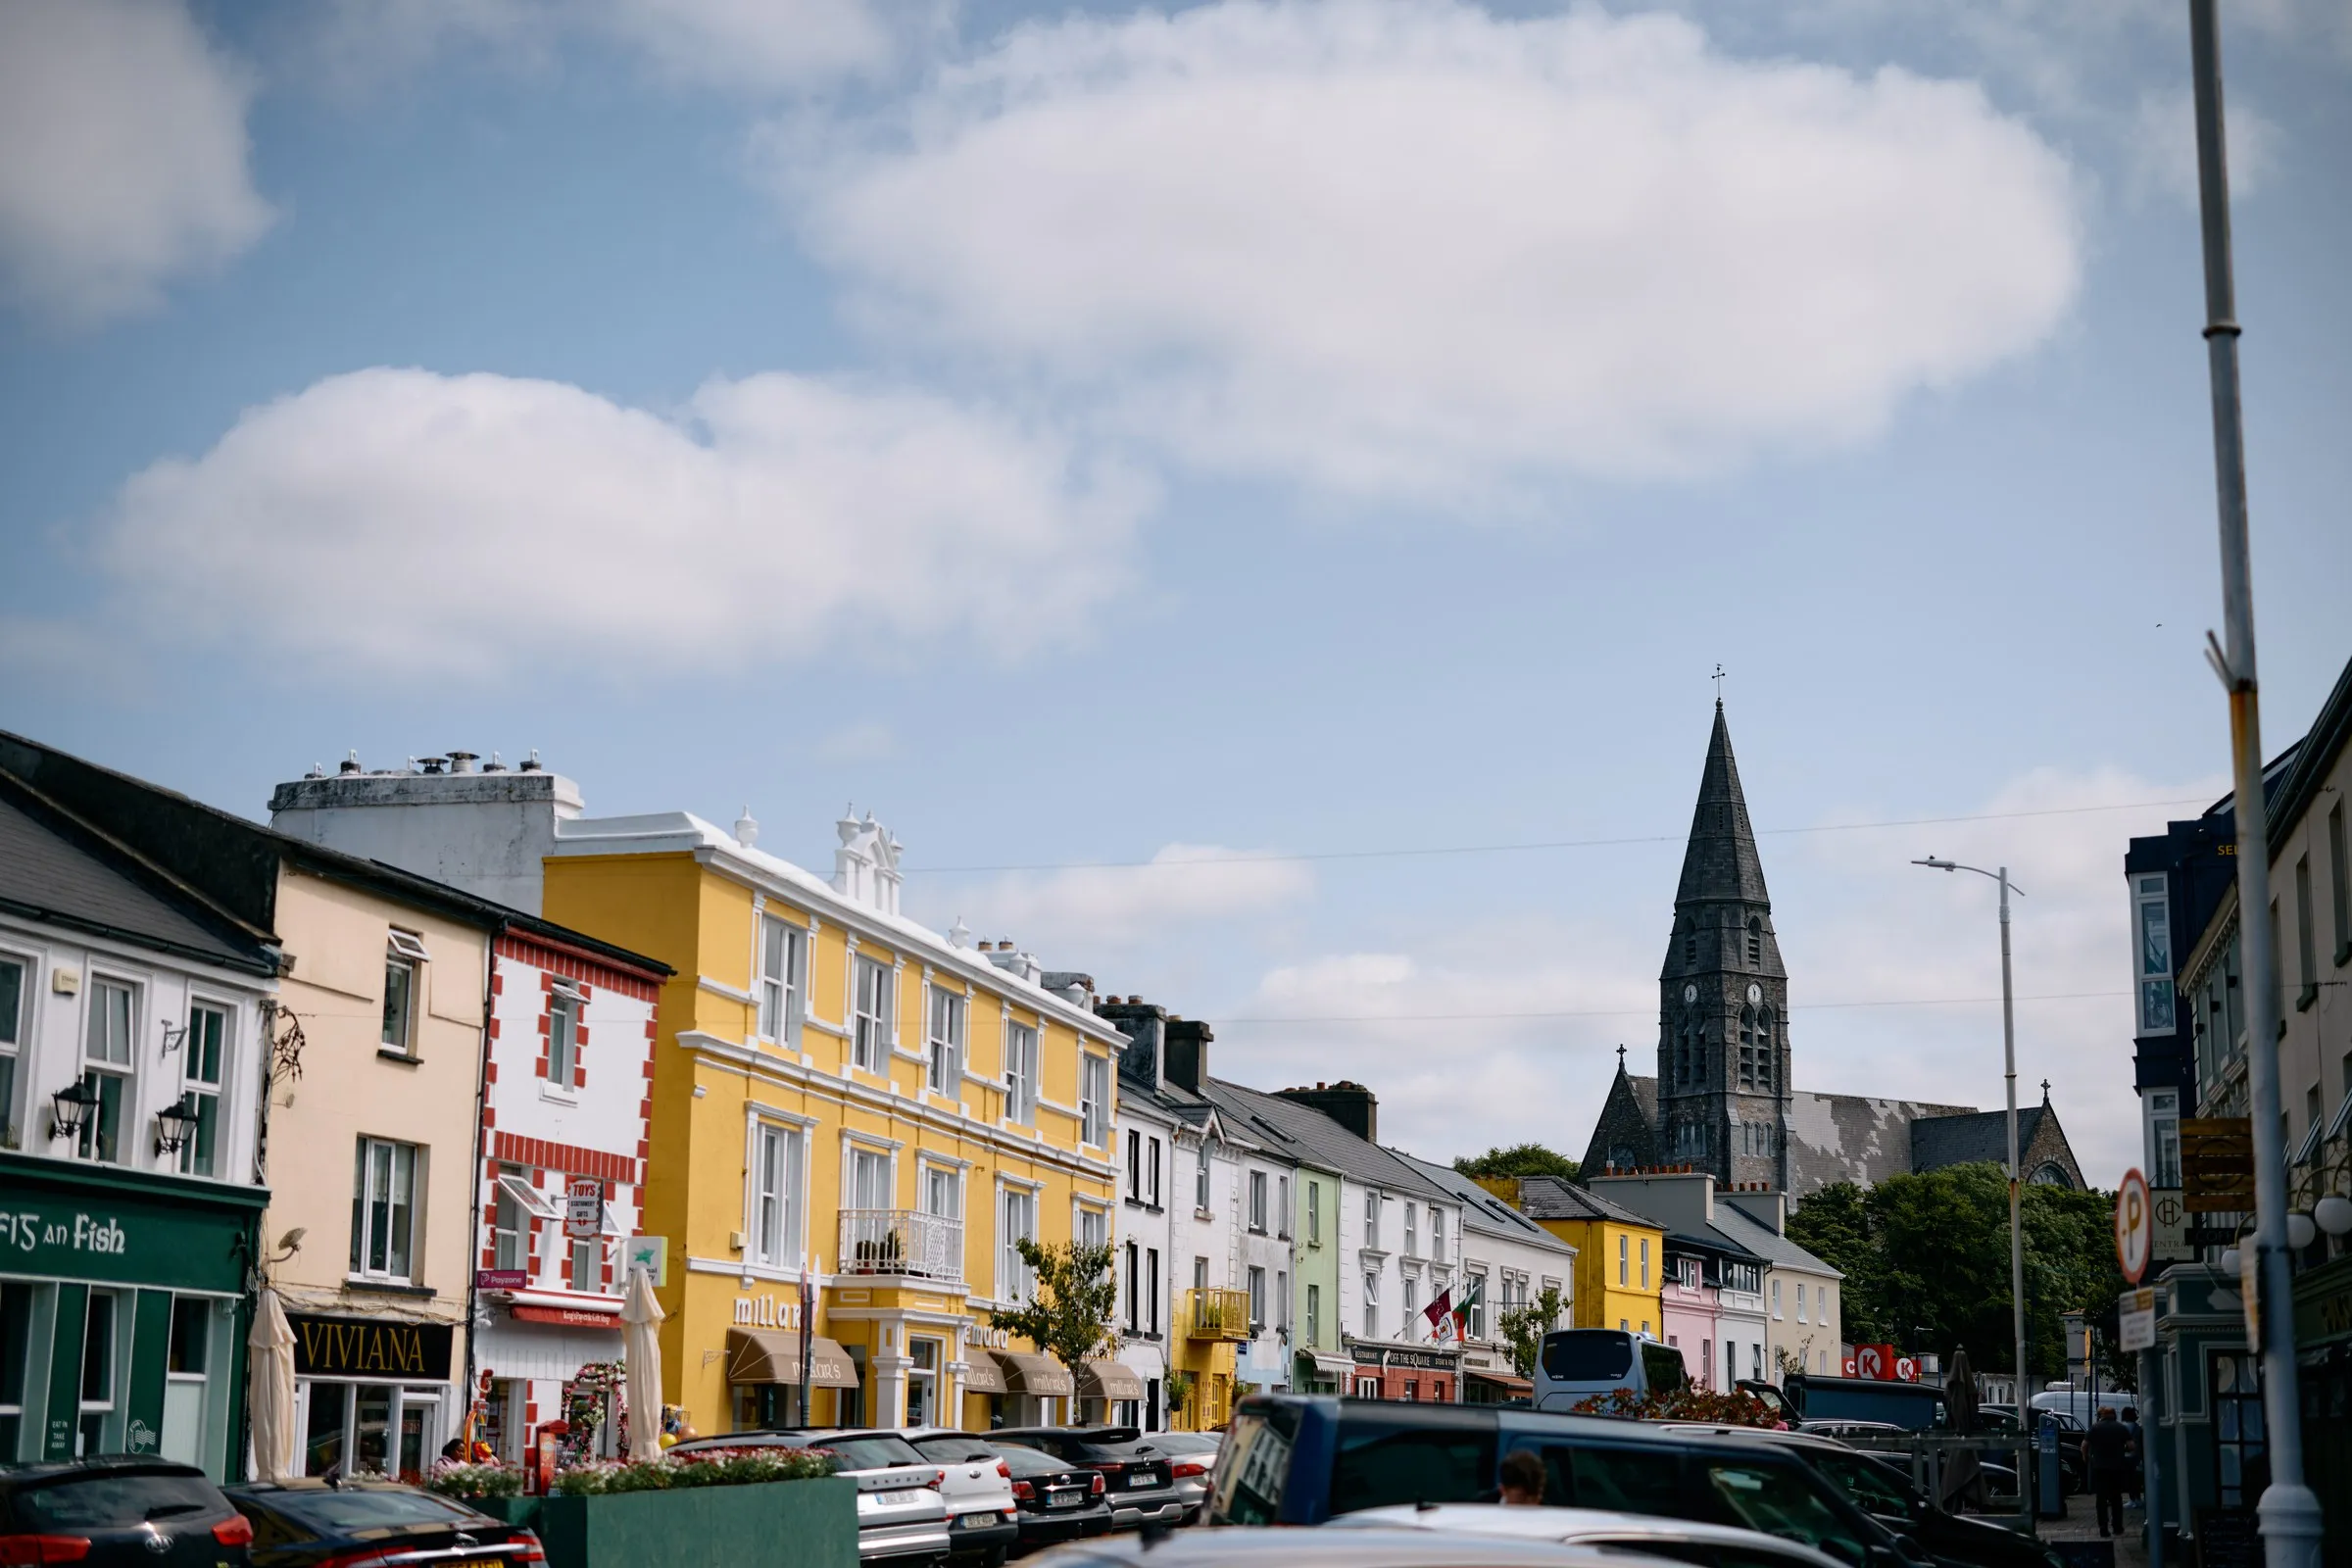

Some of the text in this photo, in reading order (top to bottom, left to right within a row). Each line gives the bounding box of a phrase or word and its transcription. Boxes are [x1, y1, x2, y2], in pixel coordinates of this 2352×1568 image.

[573, 1184, 596, 1197] TOYS
[2154, 1240, 2187, 1249] ENTRA
[491, 1275, 522, 1285] Payzone
[733, 1294, 801, 1329] millar
[301, 1321, 425, 1372] VIVIANA
[1354, 1350, 1378, 1359] RESTAURANT
[1390, 1352, 1399, 1363] OFF
[1399, 1353, 1409, 1364] THE
[1862, 1354, 1880, 1379] K
[1901, 1361, 1912, 1378] K
